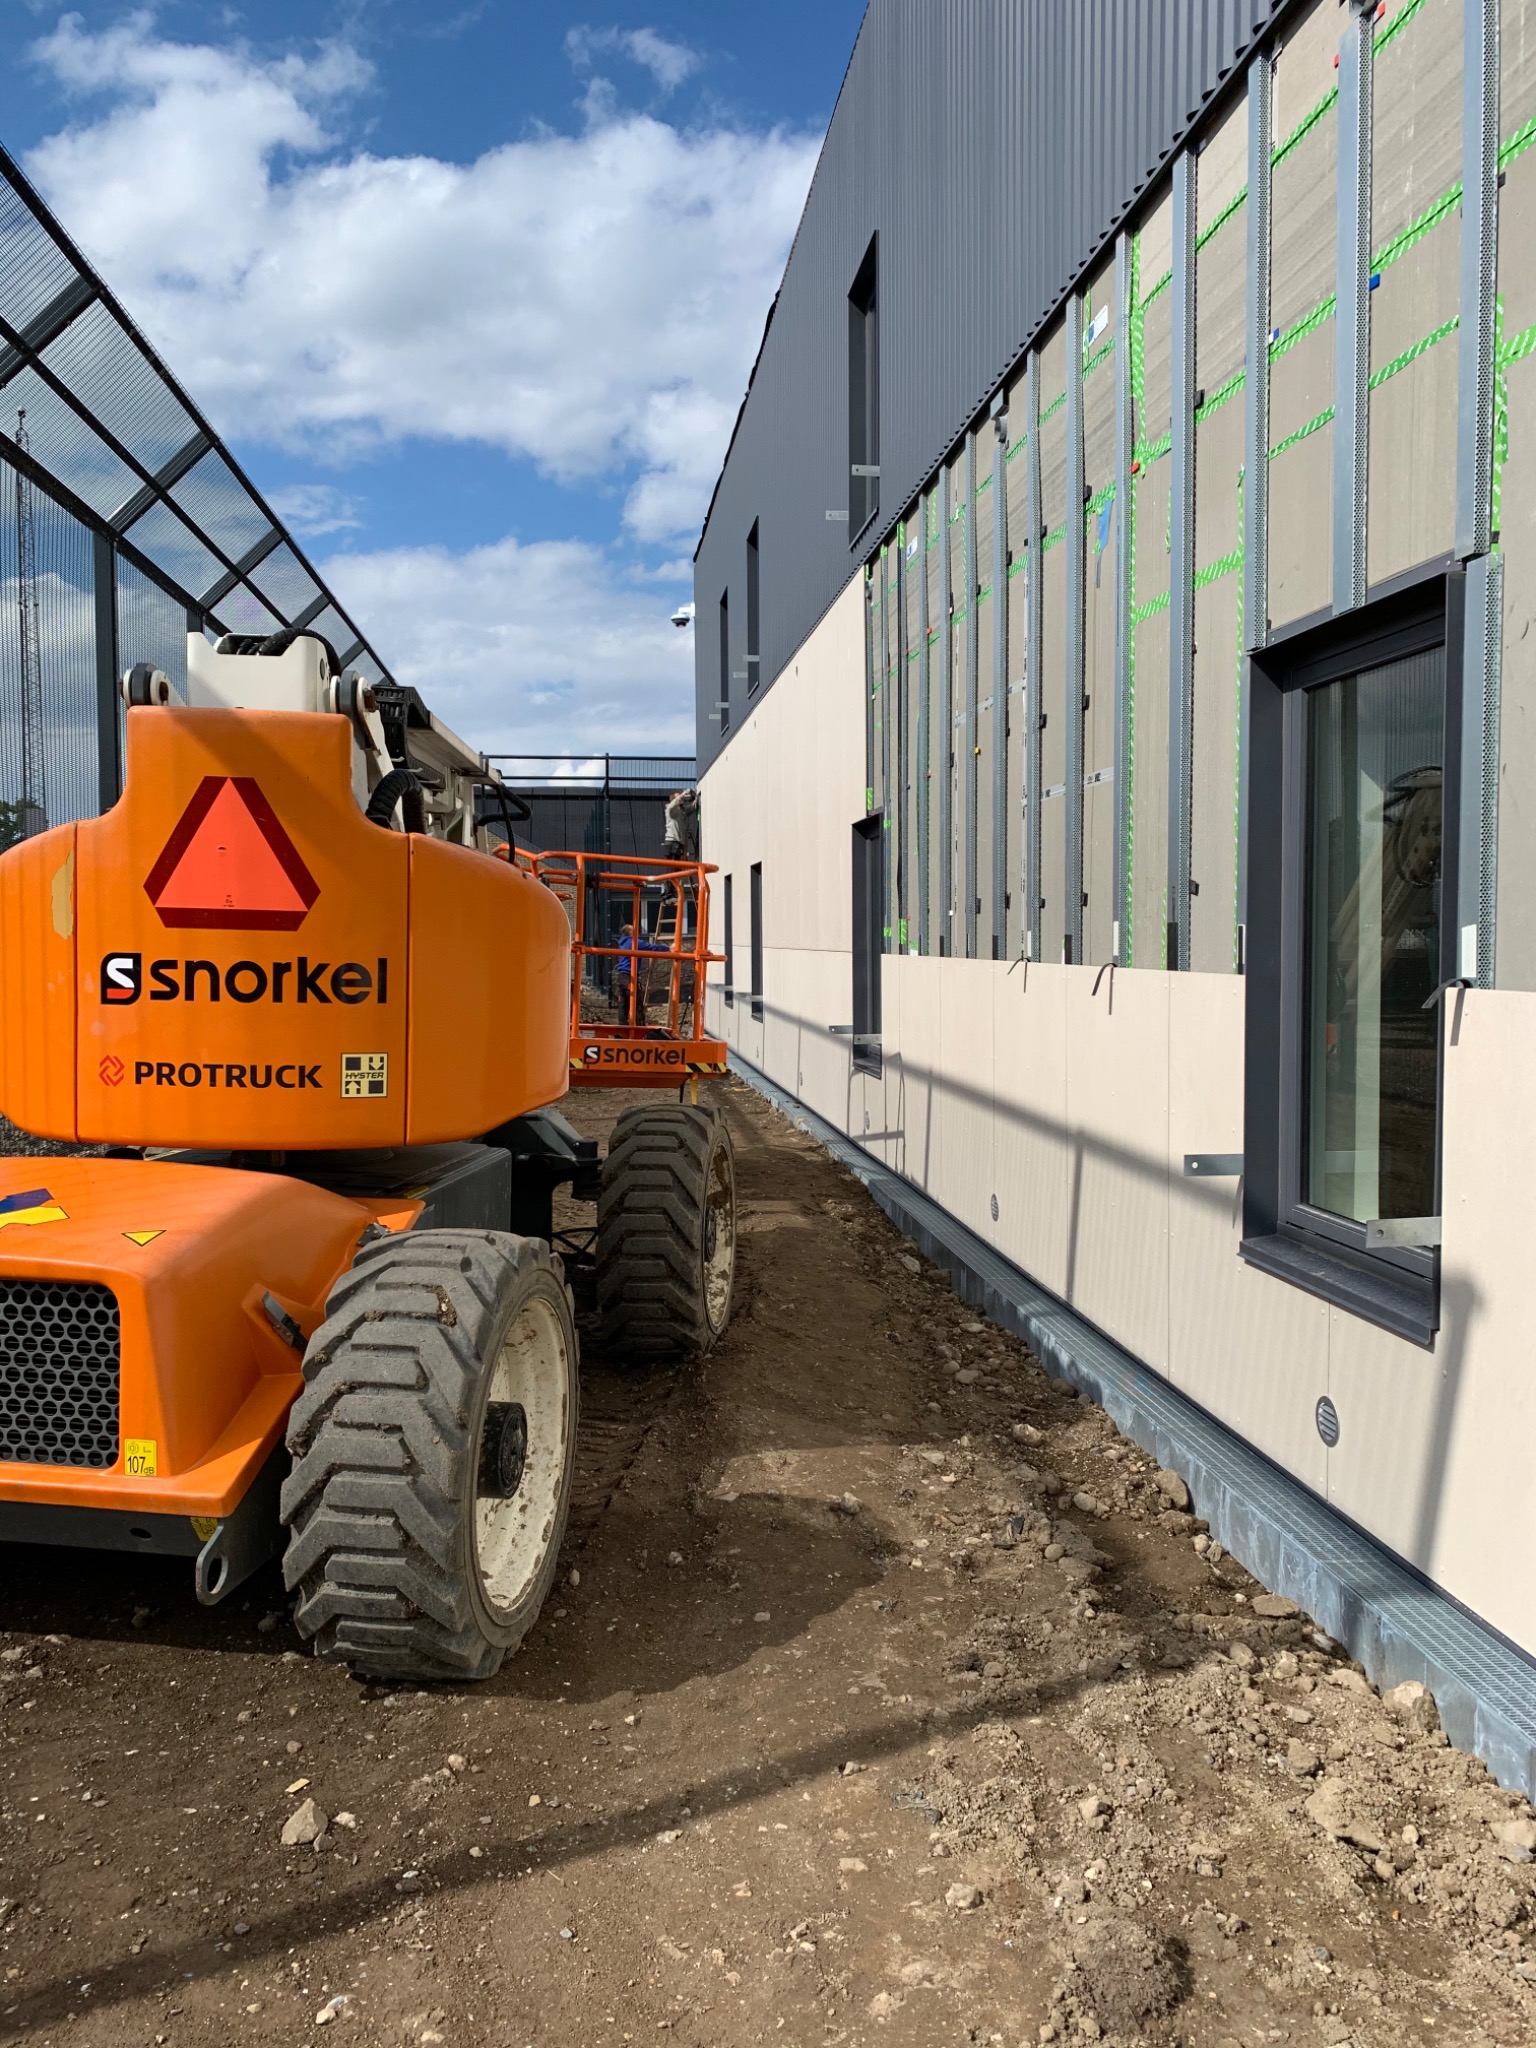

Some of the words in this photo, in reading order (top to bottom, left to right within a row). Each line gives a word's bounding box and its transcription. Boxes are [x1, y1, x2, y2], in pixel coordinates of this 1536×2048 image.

[149, 956, 388, 1004] snorkel
[603, 1047, 686, 1066] snorkel
[134, 1060, 324, 1090] PROTRUCK
[345, 1071, 384, 1080] HYSTER
[127, 1455, 146, 1474] 107
[143, 1466, 155, 1475] dB
